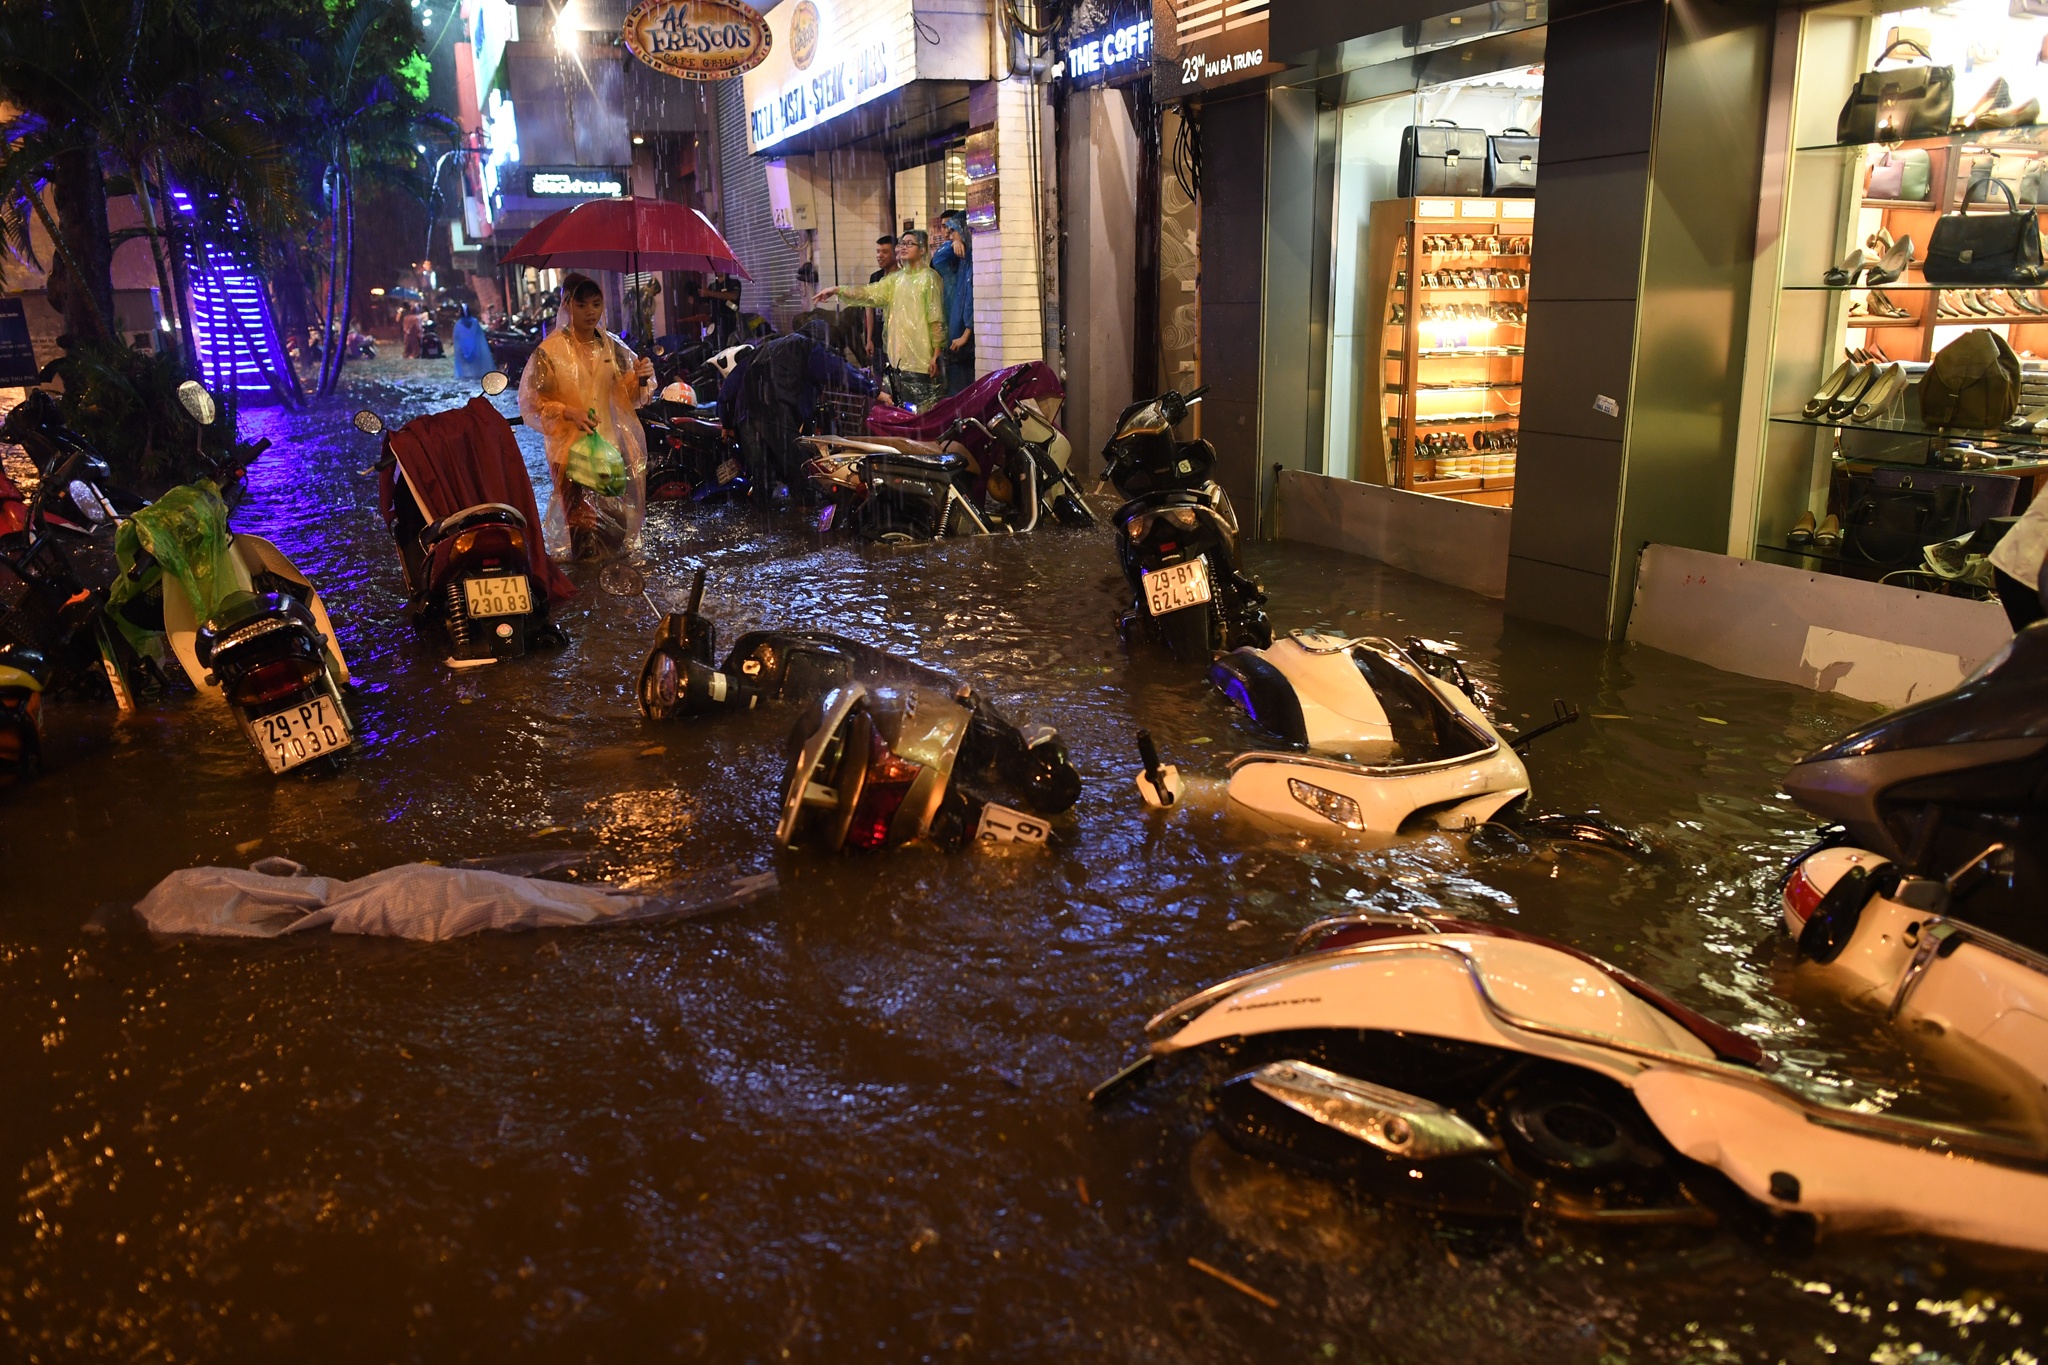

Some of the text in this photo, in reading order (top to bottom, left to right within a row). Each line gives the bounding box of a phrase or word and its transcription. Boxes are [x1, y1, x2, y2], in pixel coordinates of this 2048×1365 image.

[660, 4, 688, 32] Al
[1069, 41, 1099, 78] THE
[1205, 61, 1219, 78] HAI
[1234, 49, 1263, 70] TRUNG
[812, 62, 846, 115] STEAK
[475, 578, 518, 596] 14-Z1
[1152, 564, 1194, 592] 29-B1
[471, 595, 528, 615] 230.83
[1152, 582, 1206, 612] 624.51
[263, 701, 325, 744] 29-P7
[274, 725, 338, 767] 7030
